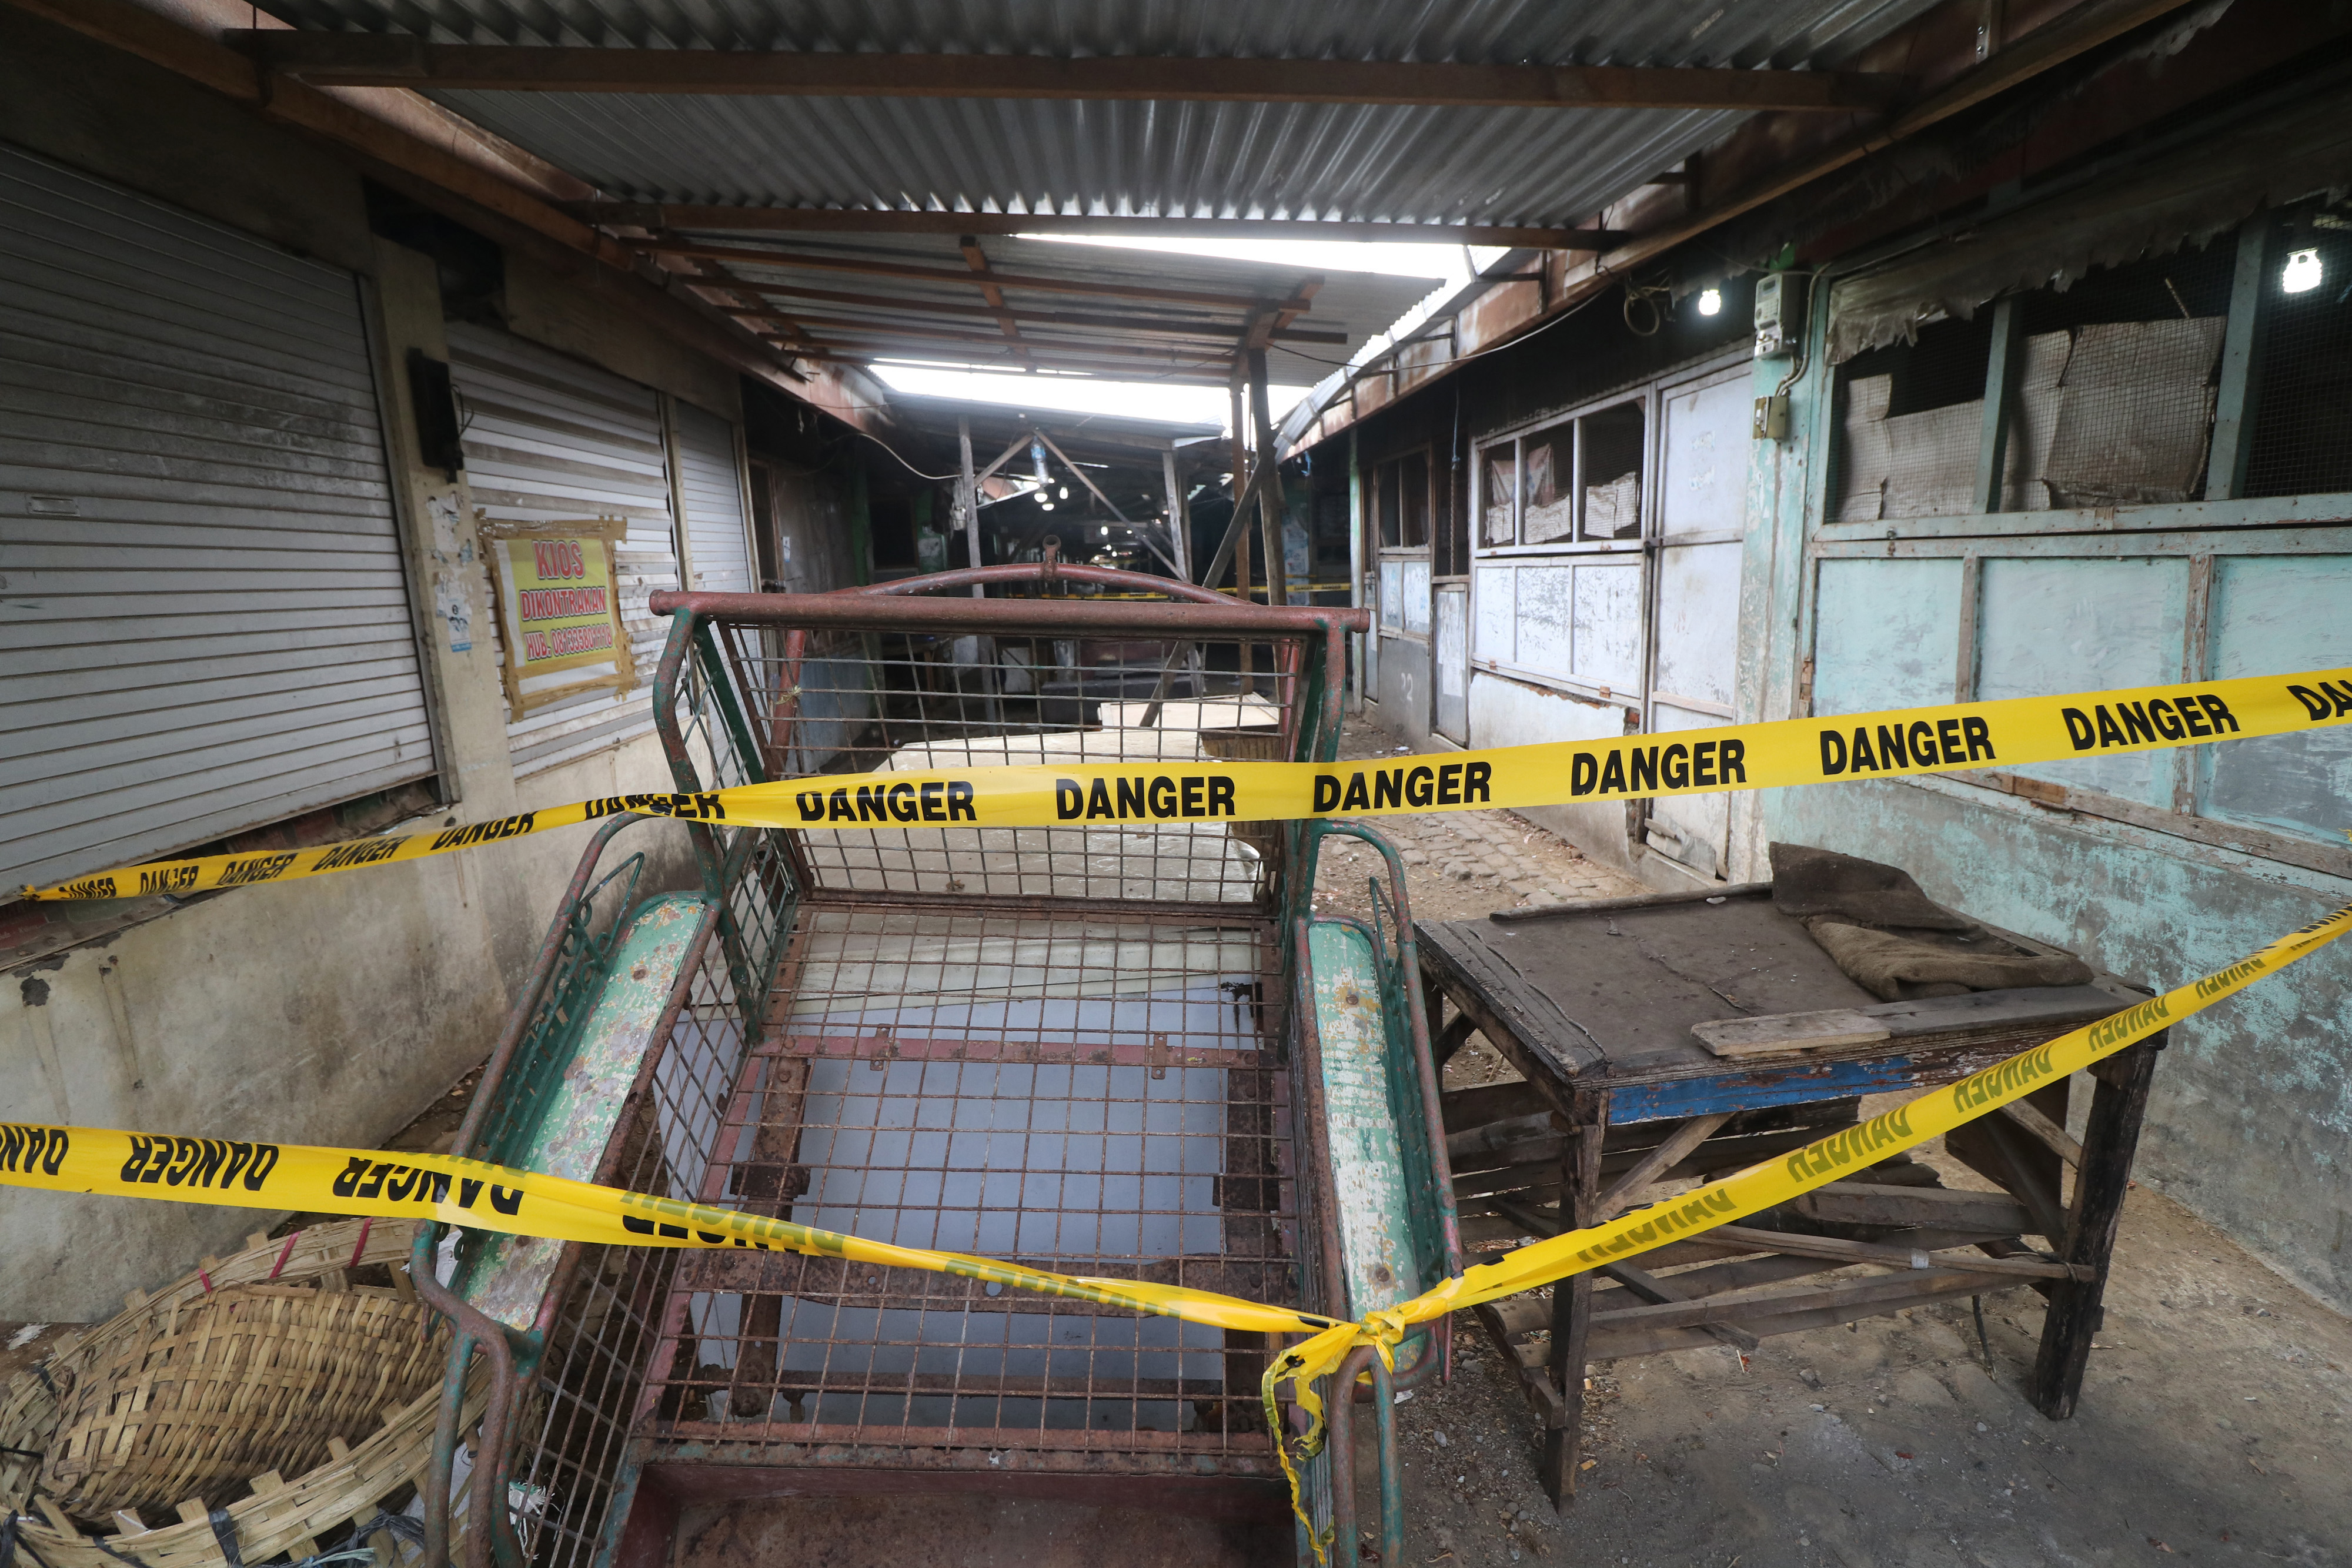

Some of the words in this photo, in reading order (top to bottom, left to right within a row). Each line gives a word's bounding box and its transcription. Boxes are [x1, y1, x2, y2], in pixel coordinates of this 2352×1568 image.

[533, 540, 585, 579] KIOS
[520, 587, 607, 621] DIKONTRAKAN
[524, 631, 552, 660] HUB.
[140, 865, 199, 894] DANGER
[216, 853, 298, 885] DANGER
[310, 835, 413, 872] DANGER
[430, 810, 539, 850] DANGER
[796, 781, 977, 822] DANGER
[1056, 775, 1235, 820] DANGER
[1314, 762, 1492, 813] DANGER
[1571, 739, 1747, 796] DANGER
[1820, 717, 1997, 775] DANGER
[2061, 694, 2240, 750] DANGER
[0, 1125, 69, 1175] DAN
[121, 1135, 279, 1191] DANGER
[333, 1156, 524, 1215] DANGER
